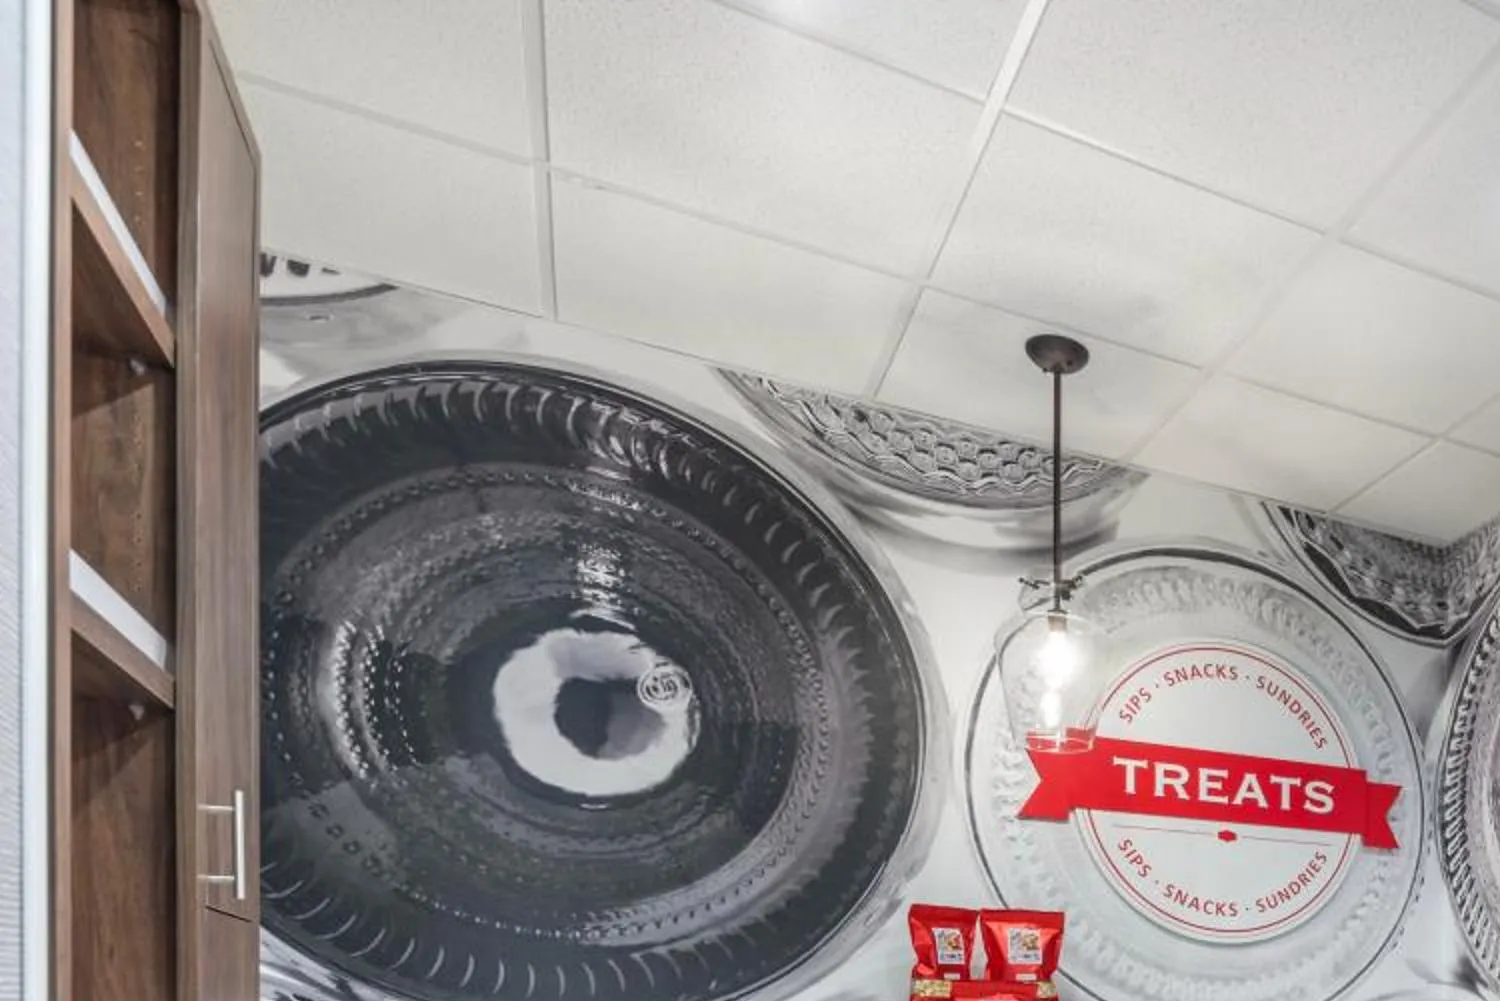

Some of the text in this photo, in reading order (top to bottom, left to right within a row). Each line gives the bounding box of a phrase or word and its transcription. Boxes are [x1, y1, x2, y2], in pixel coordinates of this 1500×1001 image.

[1119, 663, 1328, 750] SIPS SNACKS SUNDRIES
[1112, 755, 1335, 815] TREATS
[1118, 839, 1327, 917] SIPS SNACKS SUNDRIES
